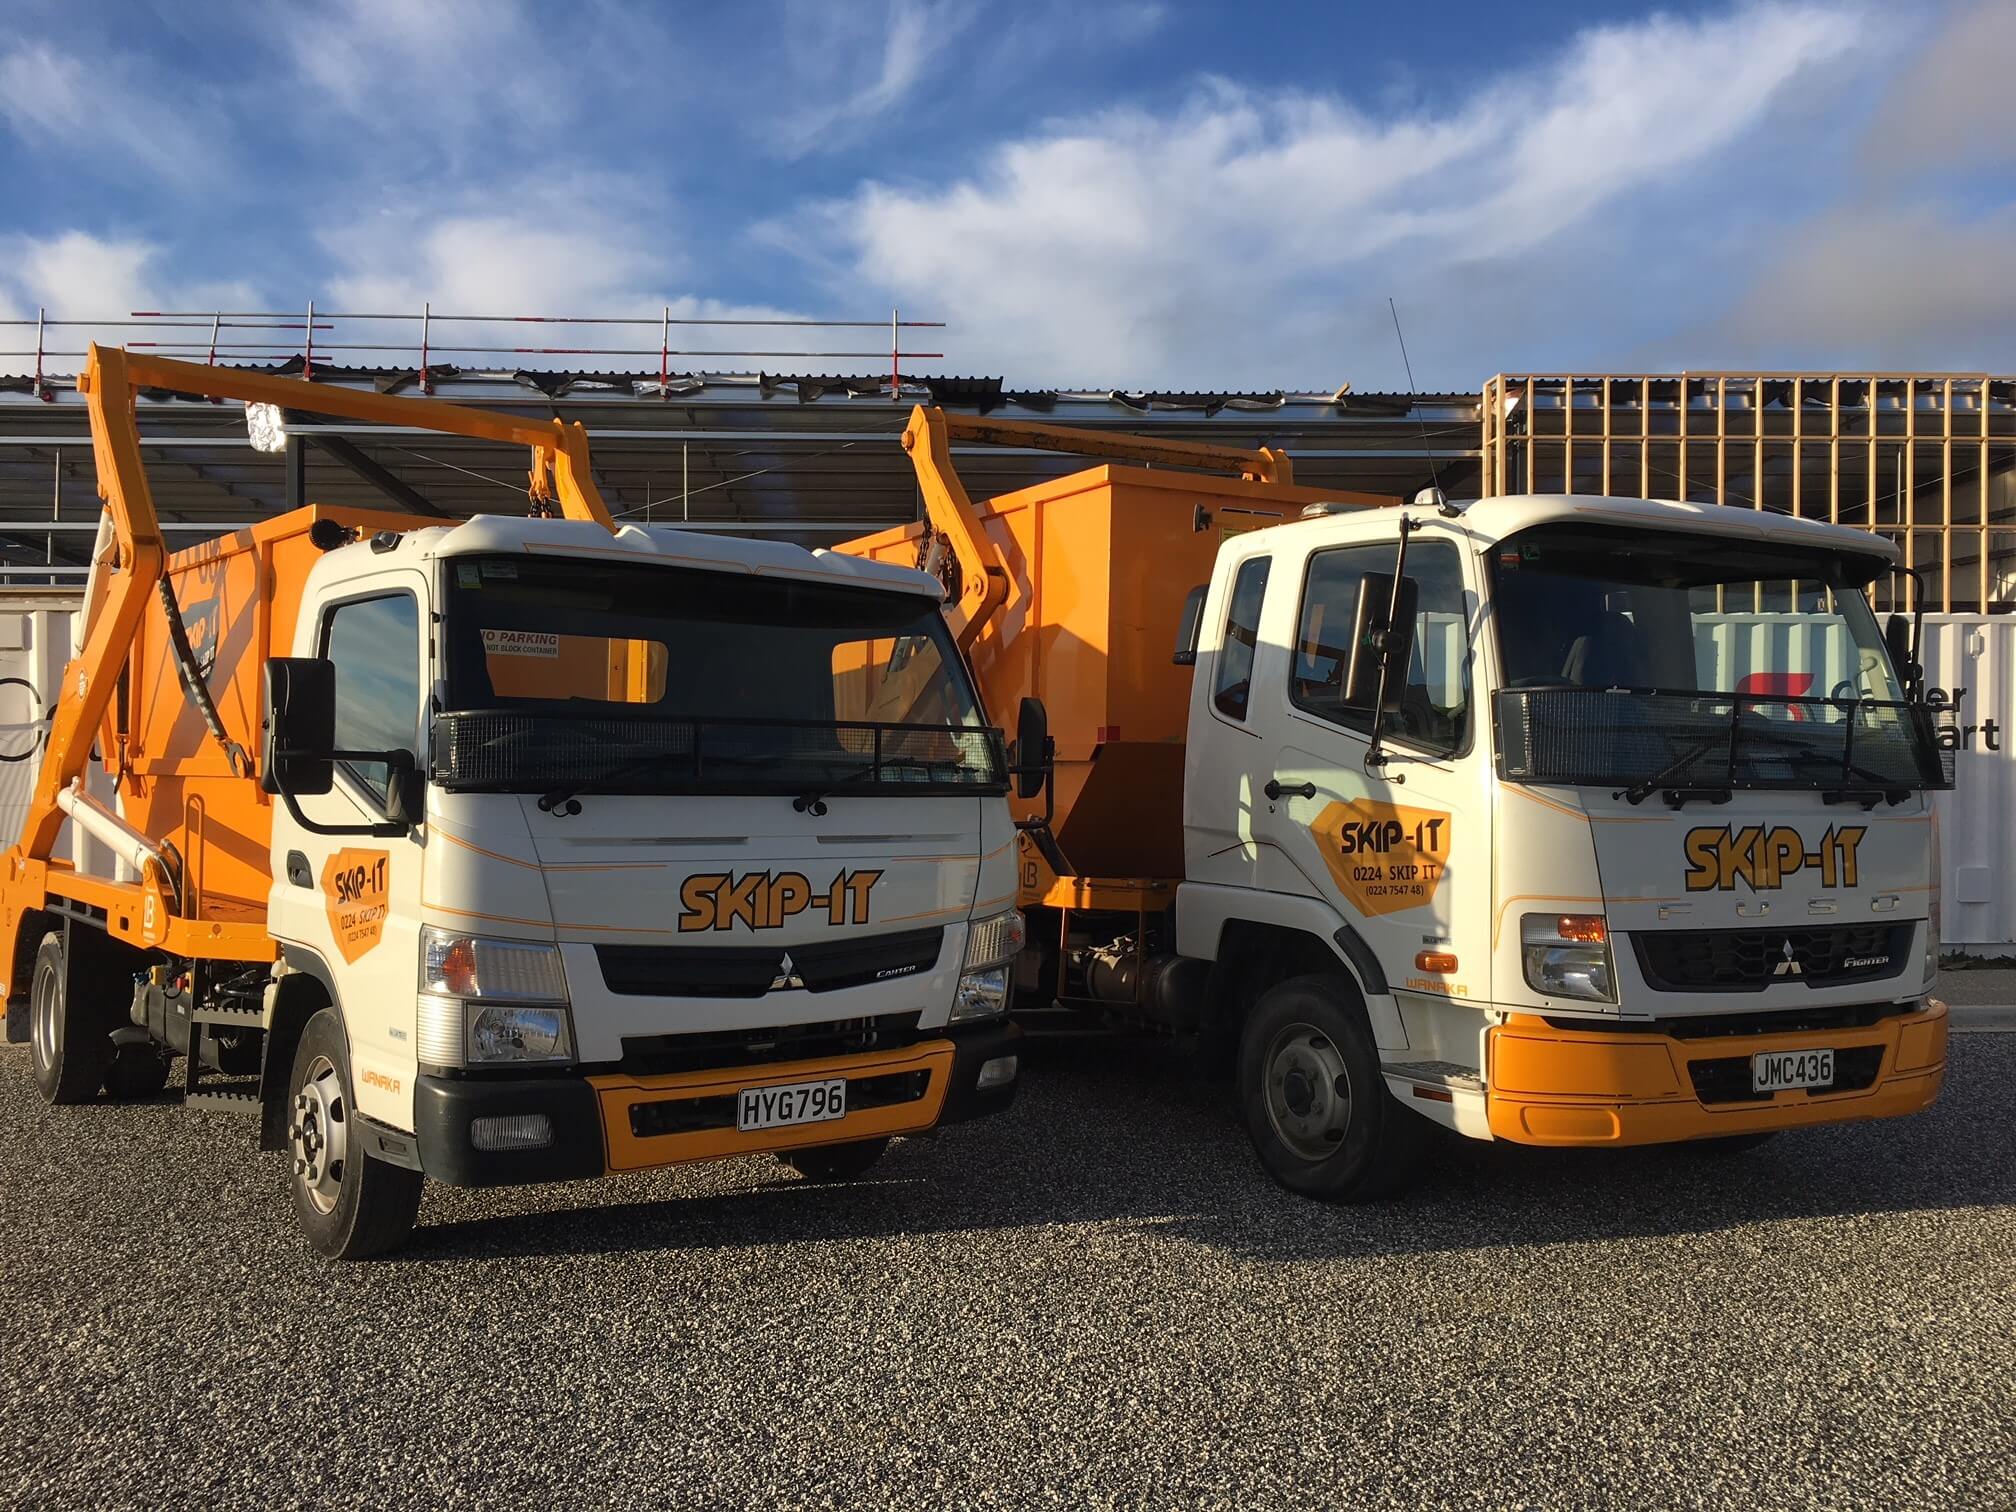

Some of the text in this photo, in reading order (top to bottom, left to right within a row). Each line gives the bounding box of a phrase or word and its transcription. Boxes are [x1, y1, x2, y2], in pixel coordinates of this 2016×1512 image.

[487, 643, 557, 655] NOT BLOCK CONTAINER
[500, 632, 557, 645] PARKING
[1341, 818, 1445, 853] SKIP-IT
[1684, 821, 1868, 894] SKIP-IT
[335, 857, 386, 904] SKIP-IT
[1354, 865, 1436, 881] 0224 SKIP IT
[678, 866, 885, 933] SKIP-IT
[1366, 885, 1424, 896] (0224 7547 48)
[341, 913, 356, 930] 0224
[359, 907, 377, 925] SKIP
[1658, 895, 1900, 920] FUSO
[876, 965, 916, 978] CANTER
[1844, 956, 1889, 968] FIGHTER
[1406, 976, 1468, 997] WANAKA
[362, 1069, 400, 1095] WANAKA
[1758, 1054, 1831, 1086] JMC436
[743, 1085, 842, 1125] HYG796
